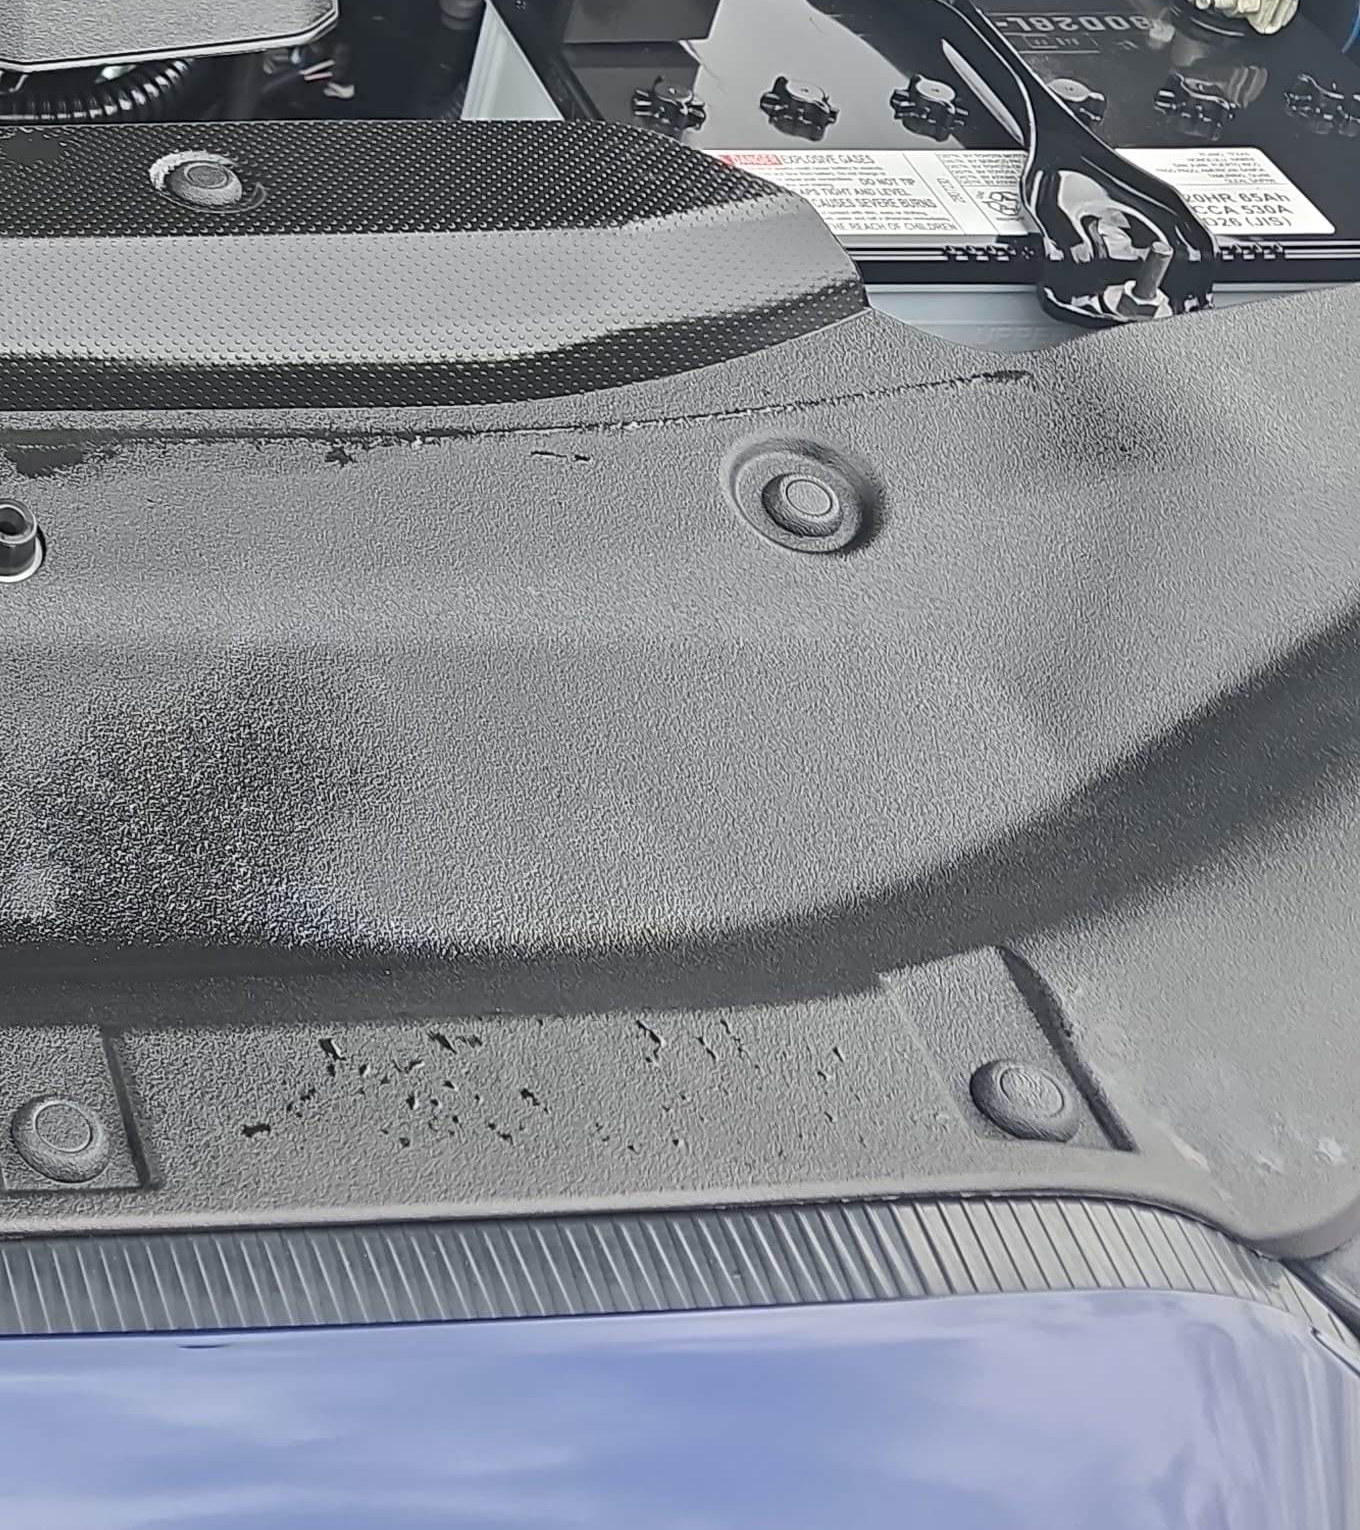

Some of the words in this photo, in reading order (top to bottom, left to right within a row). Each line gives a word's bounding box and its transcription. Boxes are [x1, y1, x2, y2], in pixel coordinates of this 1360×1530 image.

[780, 154, 838, 165] EXPLOSIVE
[839, 154, 876, 165] GASES
[858, 177, 876, 186] DO
[876, 177, 897, 186] NOT
[899, 177, 916, 186] TIP
[799, 188, 822, 196] APS
[821, 188, 852, 196] TIGHT
[854, 188, 877, 196] AND
[877, 188, 913, 197] LEVEL
[1238, 192, 1291, 203] 65Ah
[811, 198, 856, 208] CAUSES
[856, 198, 899, 208] SEVERE
[898, 198, 938, 209] BURNS
[1240, 204, 1294, 215] 530A
[848, 222, 886, 231] REACH
[887, 222, 901, 231] OF
[903, 222, 959, 231] CHILDREN
[1244, 216, 1292, 227] (JIS)
